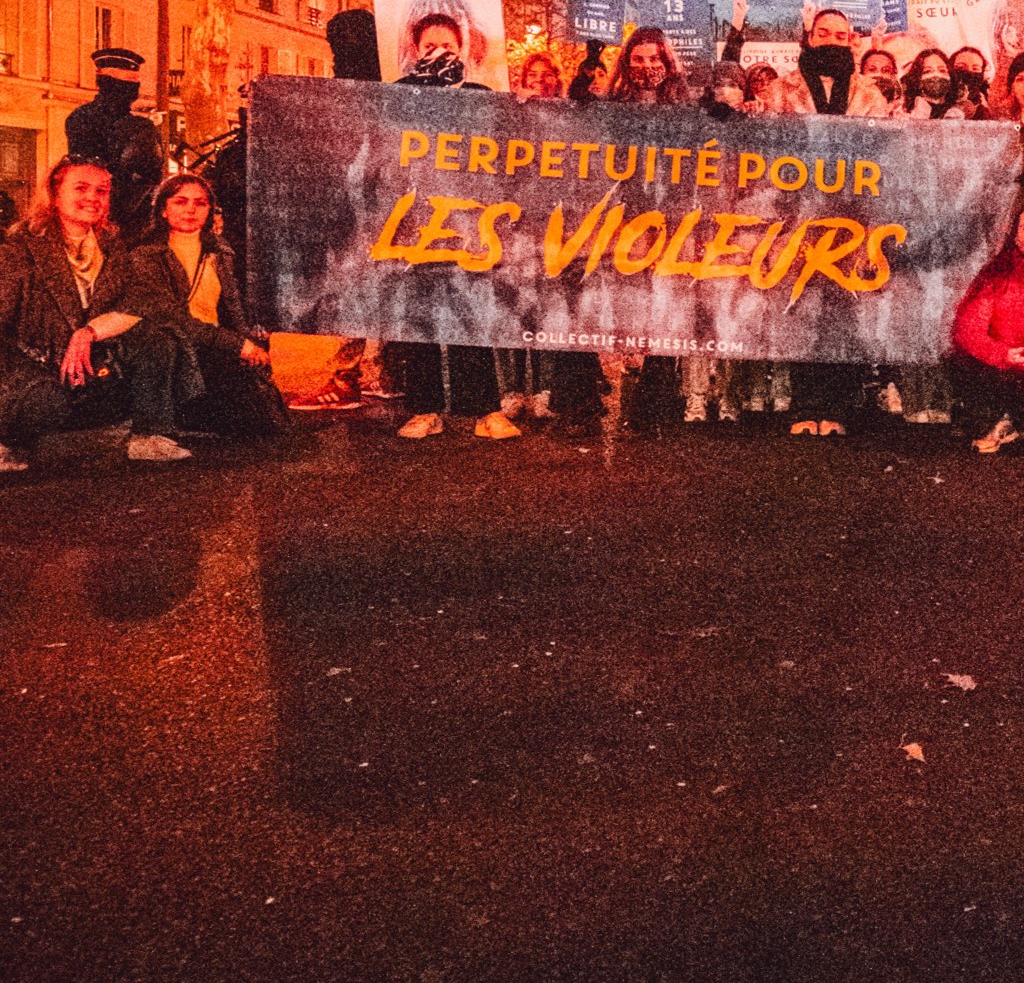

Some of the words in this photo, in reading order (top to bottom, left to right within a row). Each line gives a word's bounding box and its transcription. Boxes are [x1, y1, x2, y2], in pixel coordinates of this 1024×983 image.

[664, 0, 685, 13] 13
[574, 17, 617, 33] LIBRE
[743, 55, 778, 64] OTRE
[399, 130, 721, 187] PERPETUITÉ
[739, 152, 883, 197] POUR
[369, 187, 522, 272] LES
[543, 181, 908, 310] VIOLEURS
[522, 331, 743, 353] COLLECTIF-NEMESIS.COM
